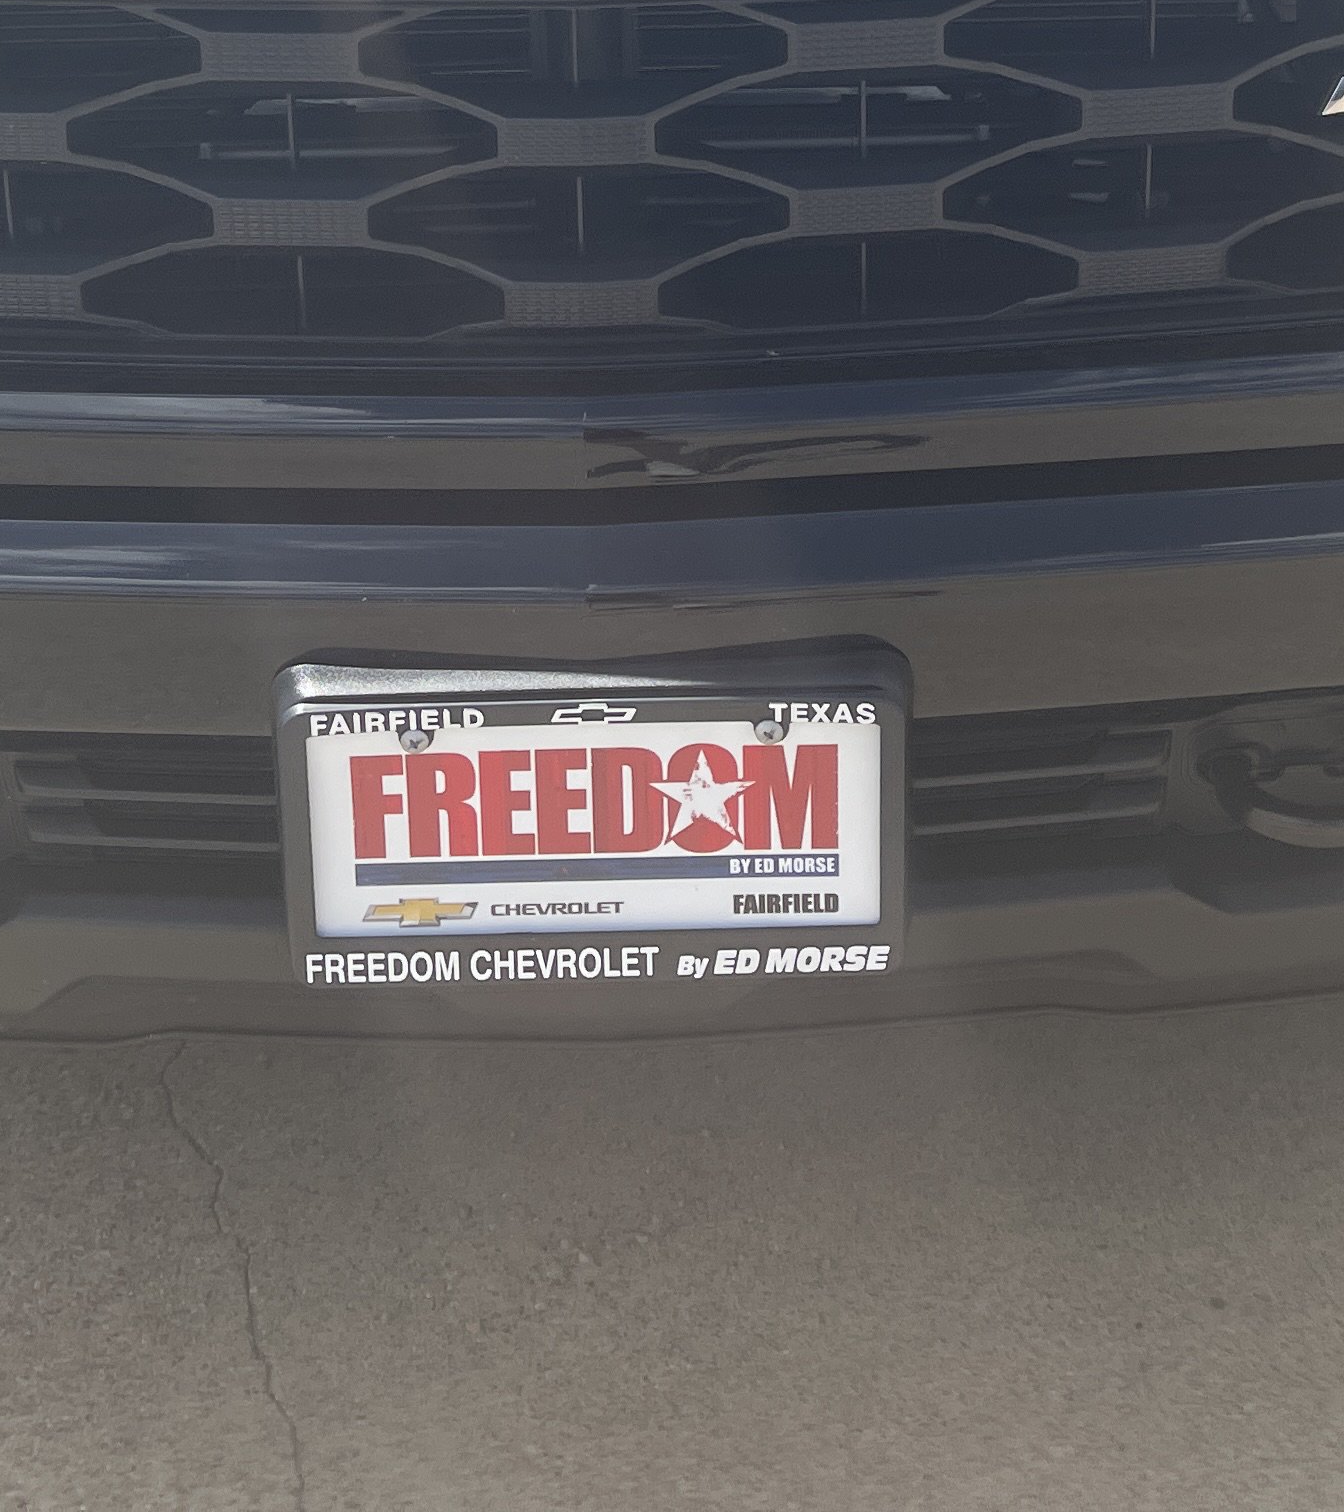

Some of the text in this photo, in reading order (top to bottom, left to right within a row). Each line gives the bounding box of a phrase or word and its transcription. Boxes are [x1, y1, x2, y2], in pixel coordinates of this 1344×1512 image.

[309, 708, 485, 736] FAIRFIELD
[768, 702, 876, 725] TEXAS
[349, 743, 840, 859] FREEDOM
[729, 856, 836, 874] BY ED MORSE
[490, 901, 625, 917] CHEVROLET
[732, 893, 840, 915] FAIRFIELD
[305, 945, 891, 984] FREEDOM CHEVROLET By ED MORSE
